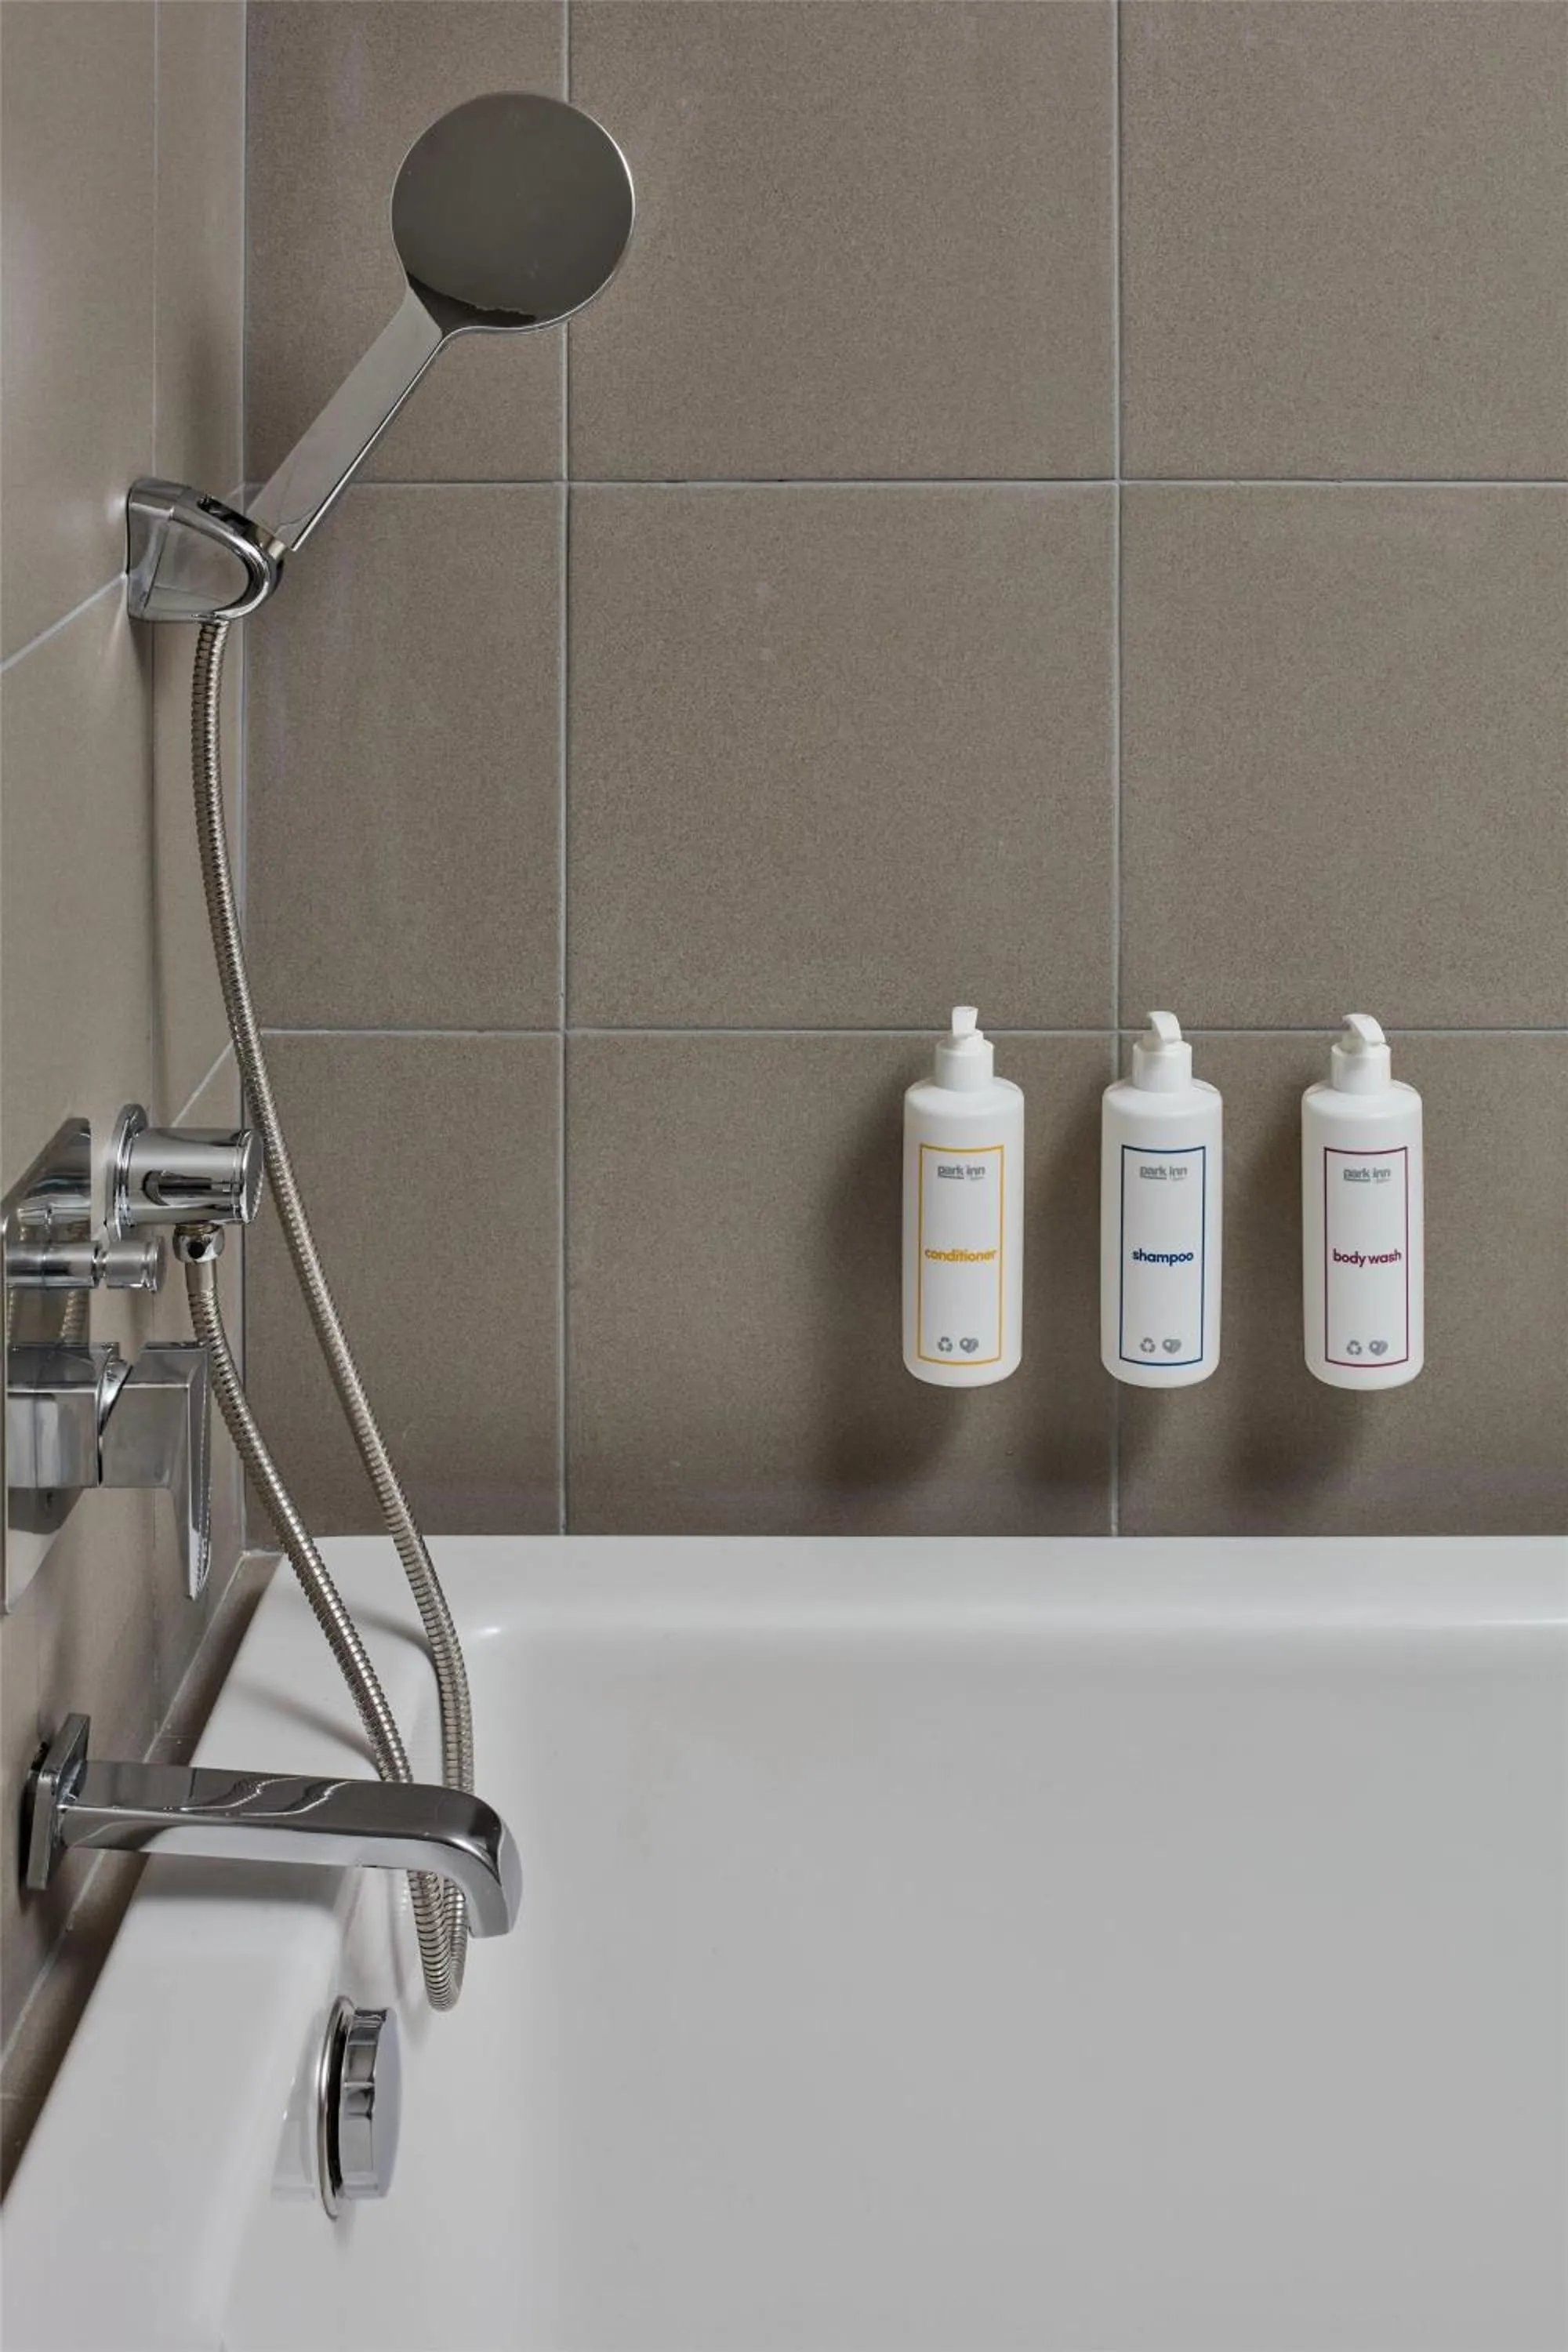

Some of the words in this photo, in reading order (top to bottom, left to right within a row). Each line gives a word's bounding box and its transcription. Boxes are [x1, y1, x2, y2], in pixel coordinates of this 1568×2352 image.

[938, 1164, 964, 1178] park
[966, 1165, 985, 1175] inn
[1140, 1164, 1167, 1178] park
[925, 1248, 996, 1261] conditioner
[1132, 1248, 1193, 1266] shampoo
[1334, 1248, 1366, 1267] body
[1367, 1248, 1401, 1264] wash
